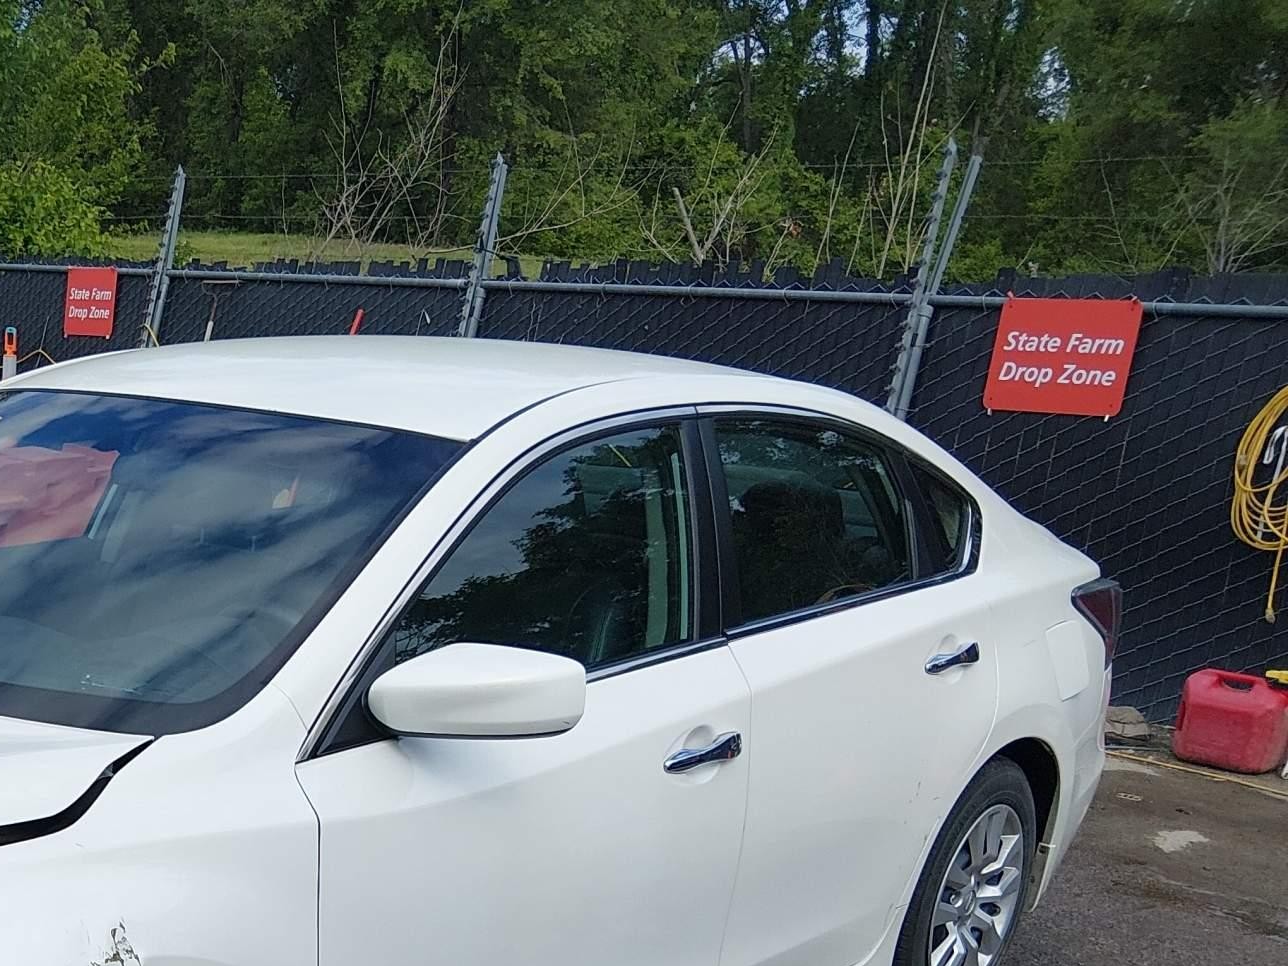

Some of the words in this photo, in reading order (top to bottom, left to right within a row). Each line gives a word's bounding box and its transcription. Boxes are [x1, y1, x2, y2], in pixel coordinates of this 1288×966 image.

[69, 287, 90, 300] State
[91, 288, 112, 301] Farm
[68, 305, 88, 320] Drop
[88, 306, 110, 319] Zone
[1003, 331, 1061, 353] State
[1065, 333, 1125, 355] Farm
[998, 361, 1053, 388] Drop
[1057, 364, 1116, 387] Zone
